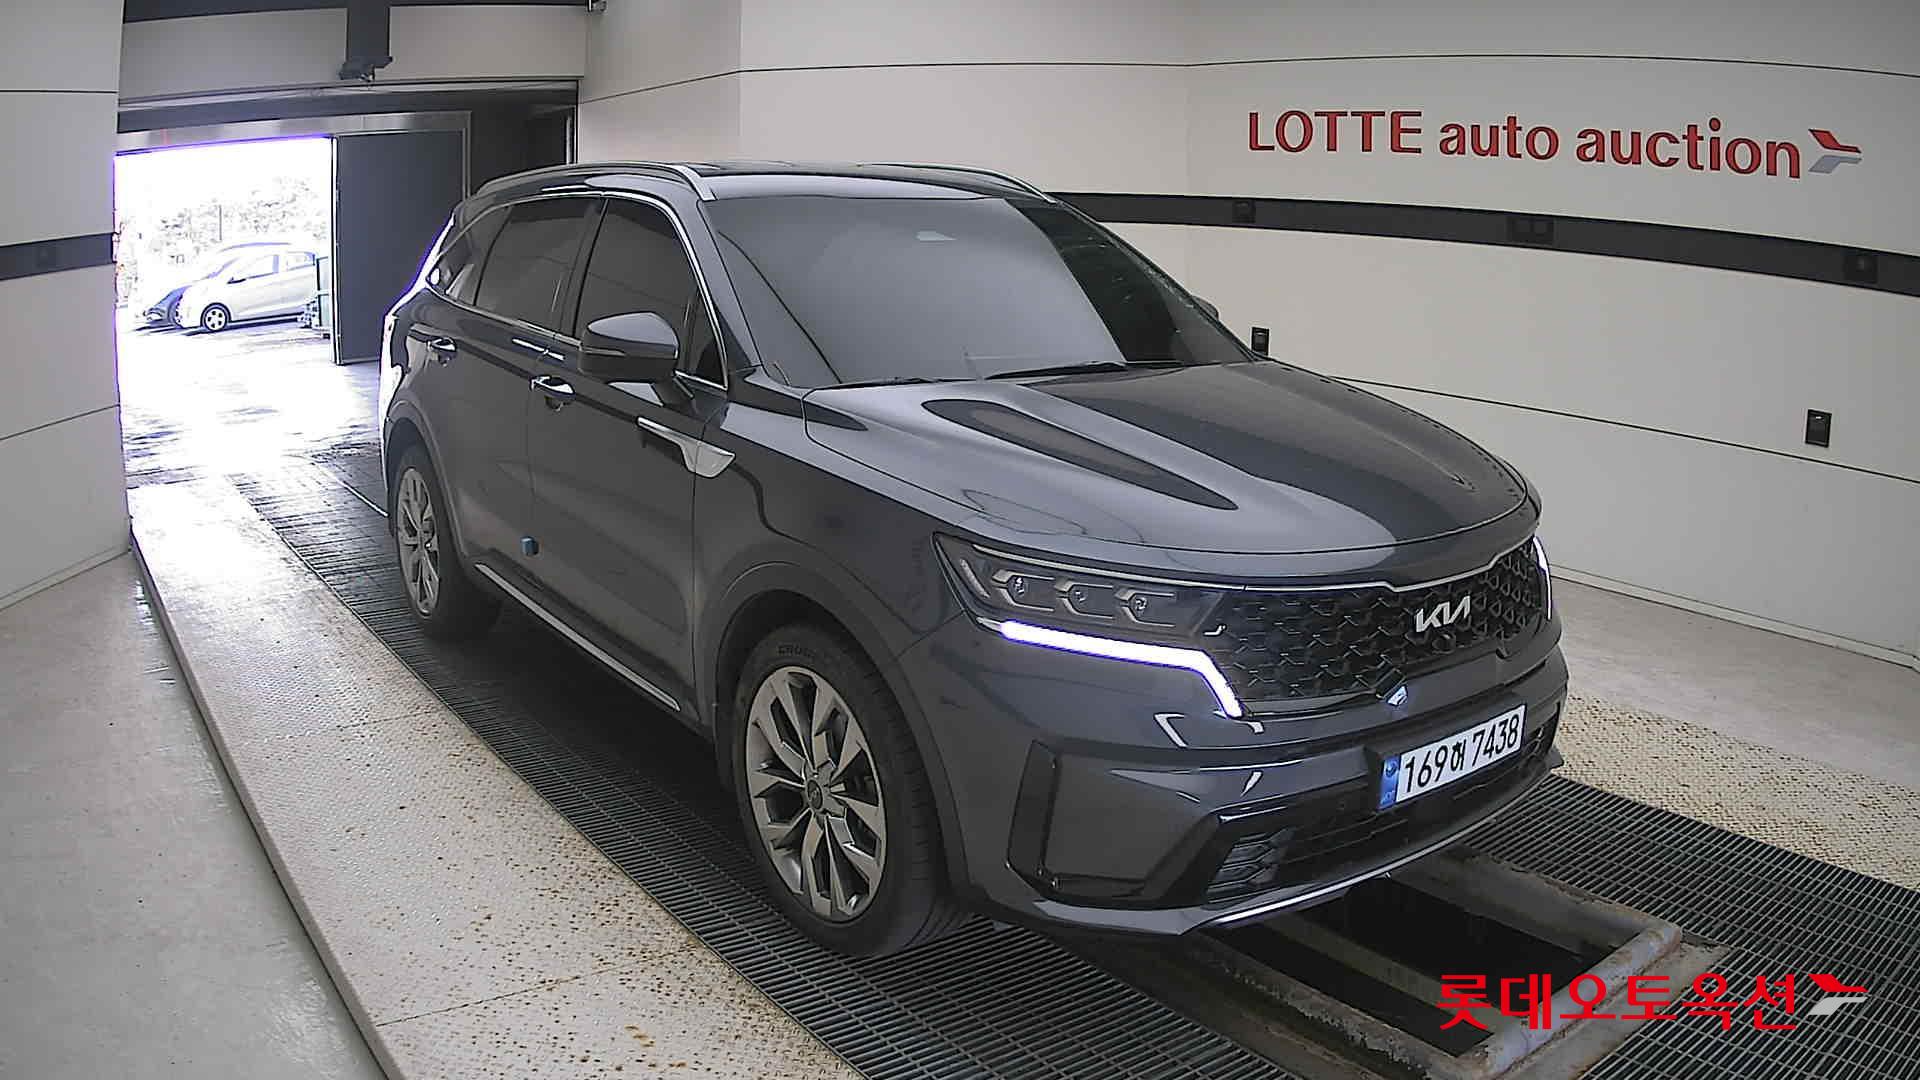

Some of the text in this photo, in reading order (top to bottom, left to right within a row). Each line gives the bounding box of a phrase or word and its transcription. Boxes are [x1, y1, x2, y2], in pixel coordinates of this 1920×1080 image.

[1248, 110, 1801, 178] LOTTE auto auction
[1405, 714, 1520, 793] 169허 7438
